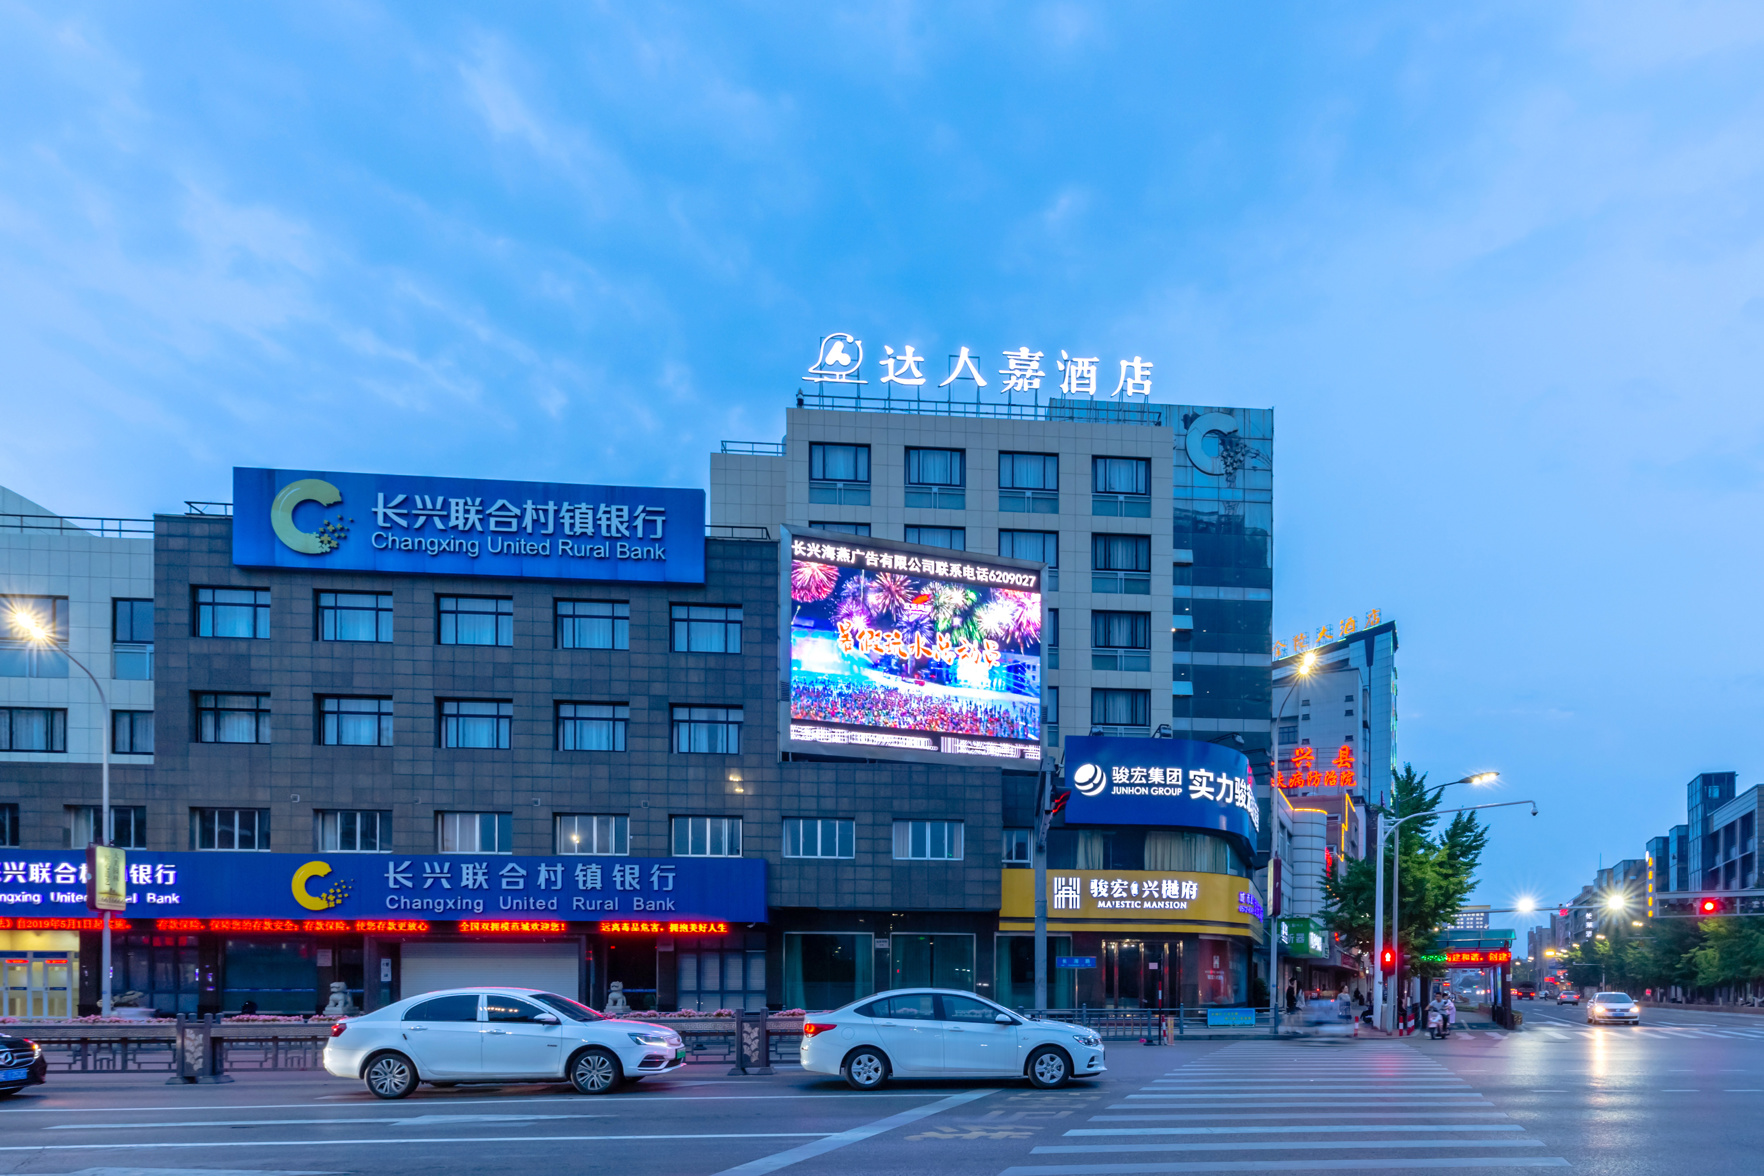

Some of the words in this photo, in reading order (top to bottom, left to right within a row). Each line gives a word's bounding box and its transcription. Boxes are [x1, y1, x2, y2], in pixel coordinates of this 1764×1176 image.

[879, 345, 1154, 397] 达人嘉酒店
[371, 492, 666, 539] 长兴联合村镇银行
[371, 532, 479, 557] Changxing
[487, 535, 551, 556] United
[558, 540, 611, 558] Rural
[617, 541, 666, 560] Bank
[791, 540, 1037, 588] 长兴海燕广告有限公司联系电话6209027
[1112, 766, 1182, 785] 骏宏集团
[1111, 786, 1149, 795] JUNHON
[1150, 787, 1183, 796] GROUP
[384, 860, 677, 891] 长兴联合村镇银行
[1090, 879, 1128, 898] 骏宏
[146, 893, 181, 904] Bank
[386, 894, 484, 913] Changxing
[499, 895, 557, 911] United
[573, 897, 618, 911] Rural
[634, 898, 675, 911] Bank
[1143, 901, 1187, 910] MANSION
